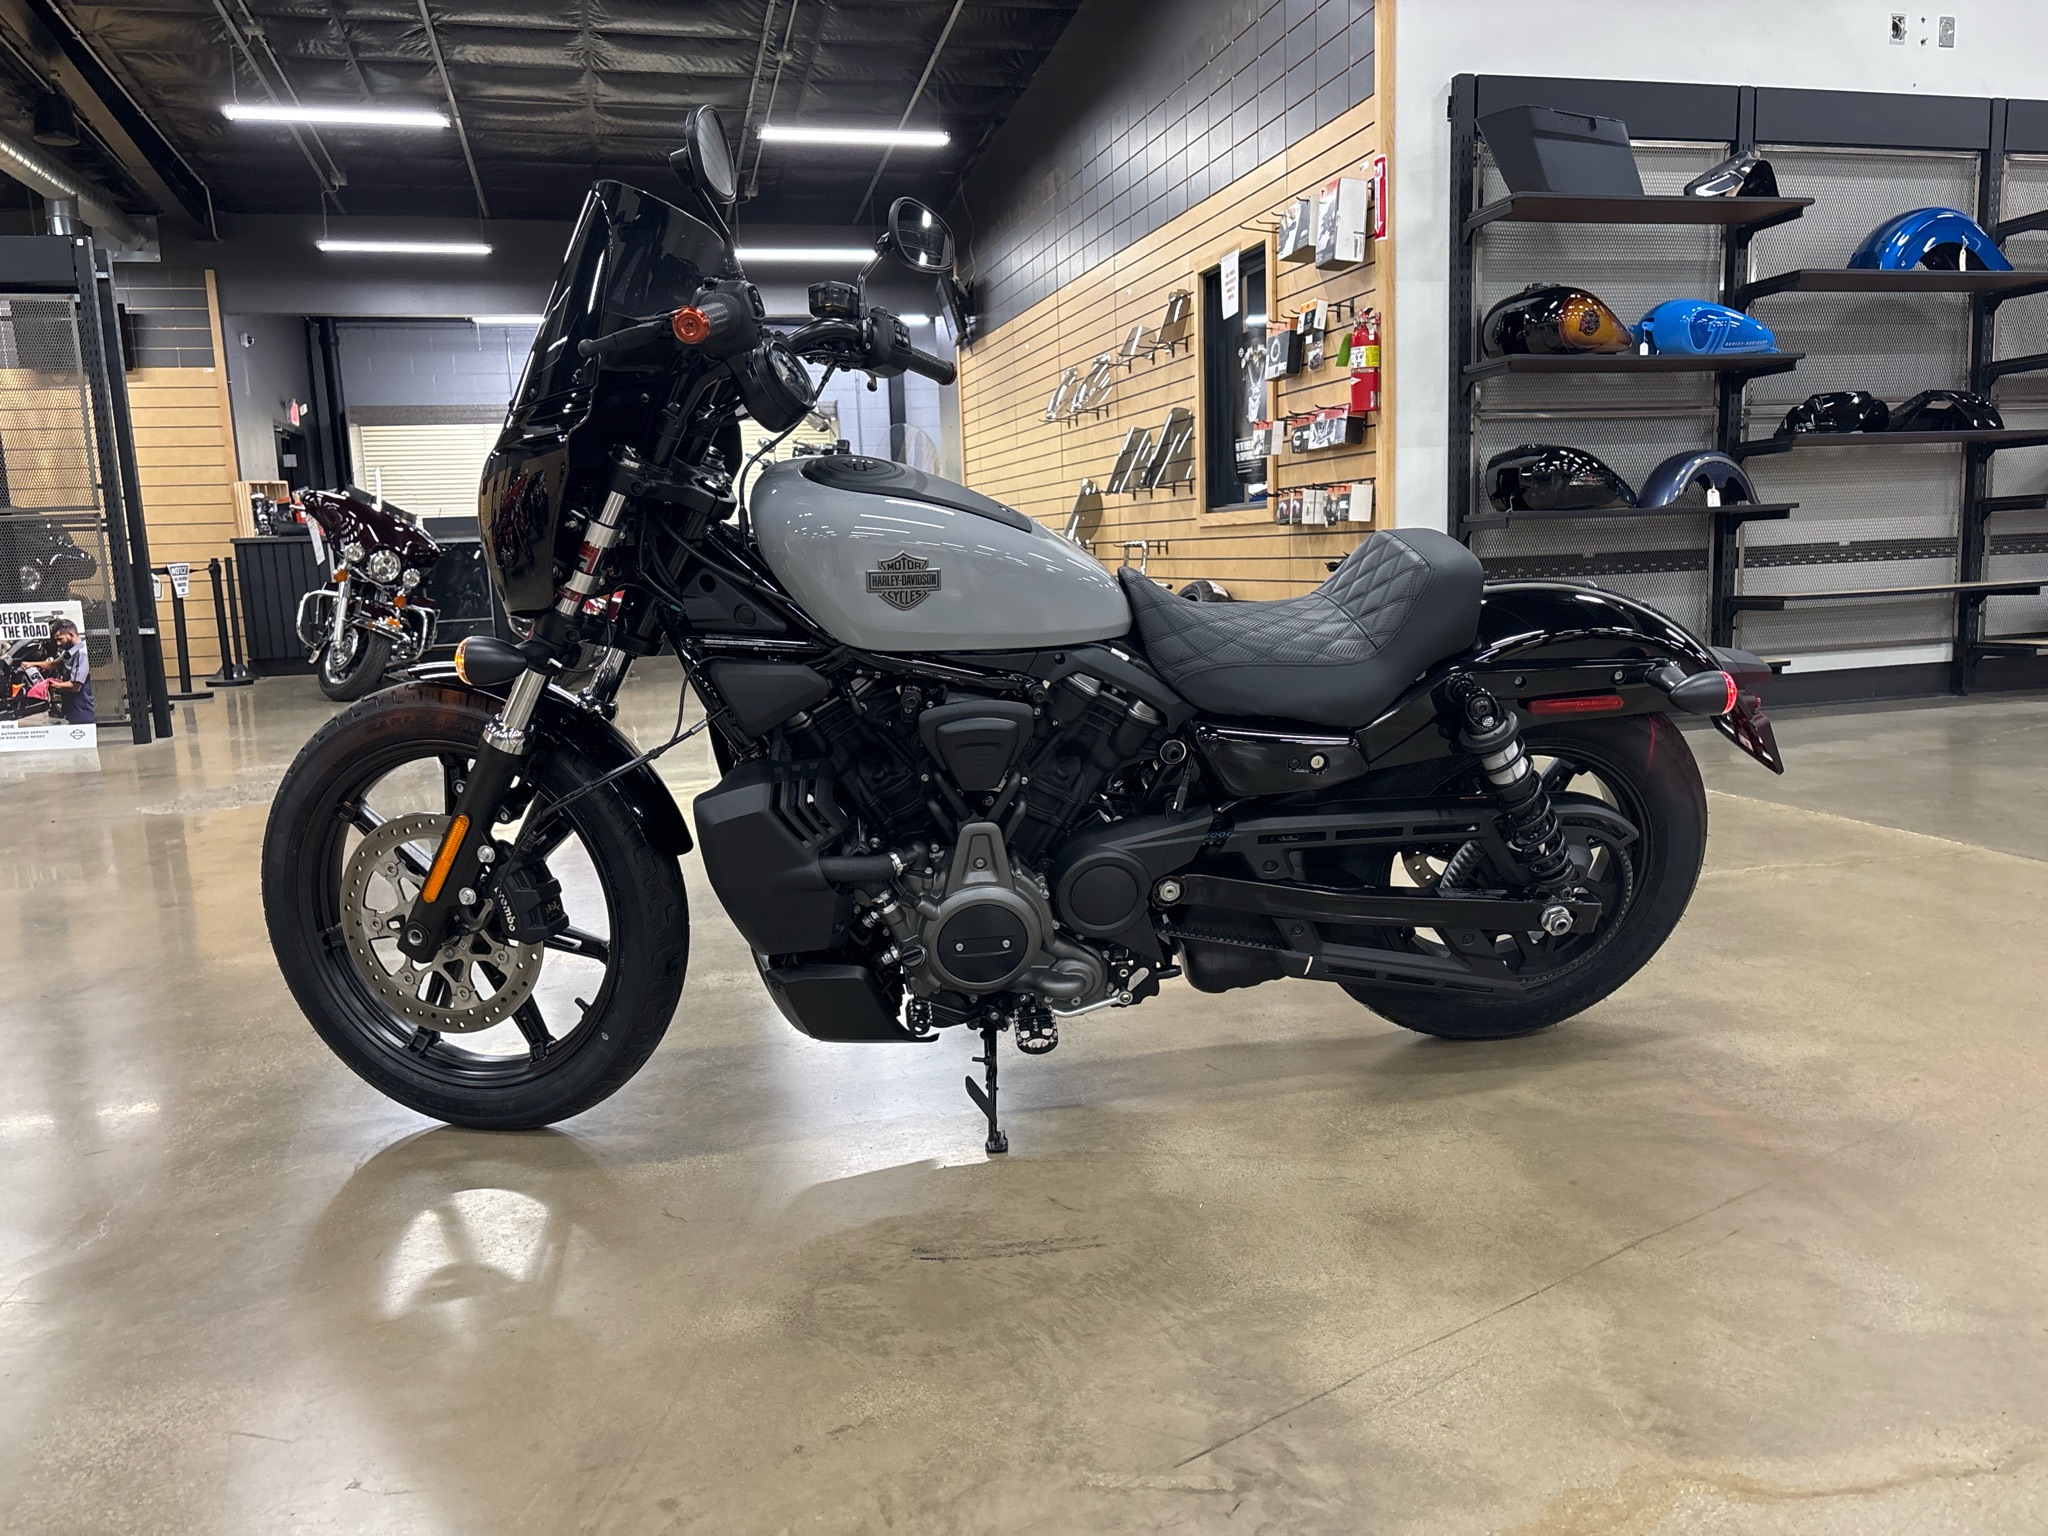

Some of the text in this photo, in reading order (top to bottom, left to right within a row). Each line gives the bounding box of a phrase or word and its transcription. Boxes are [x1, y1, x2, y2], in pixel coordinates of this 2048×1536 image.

[887, 557, 921, 570] MOTOR
[872, 574, 936, 586] HARLEY-DAVIDSON
[888, 590, 922, 605] CYCLES
[1, 625, 48, 638] THE ROAD
